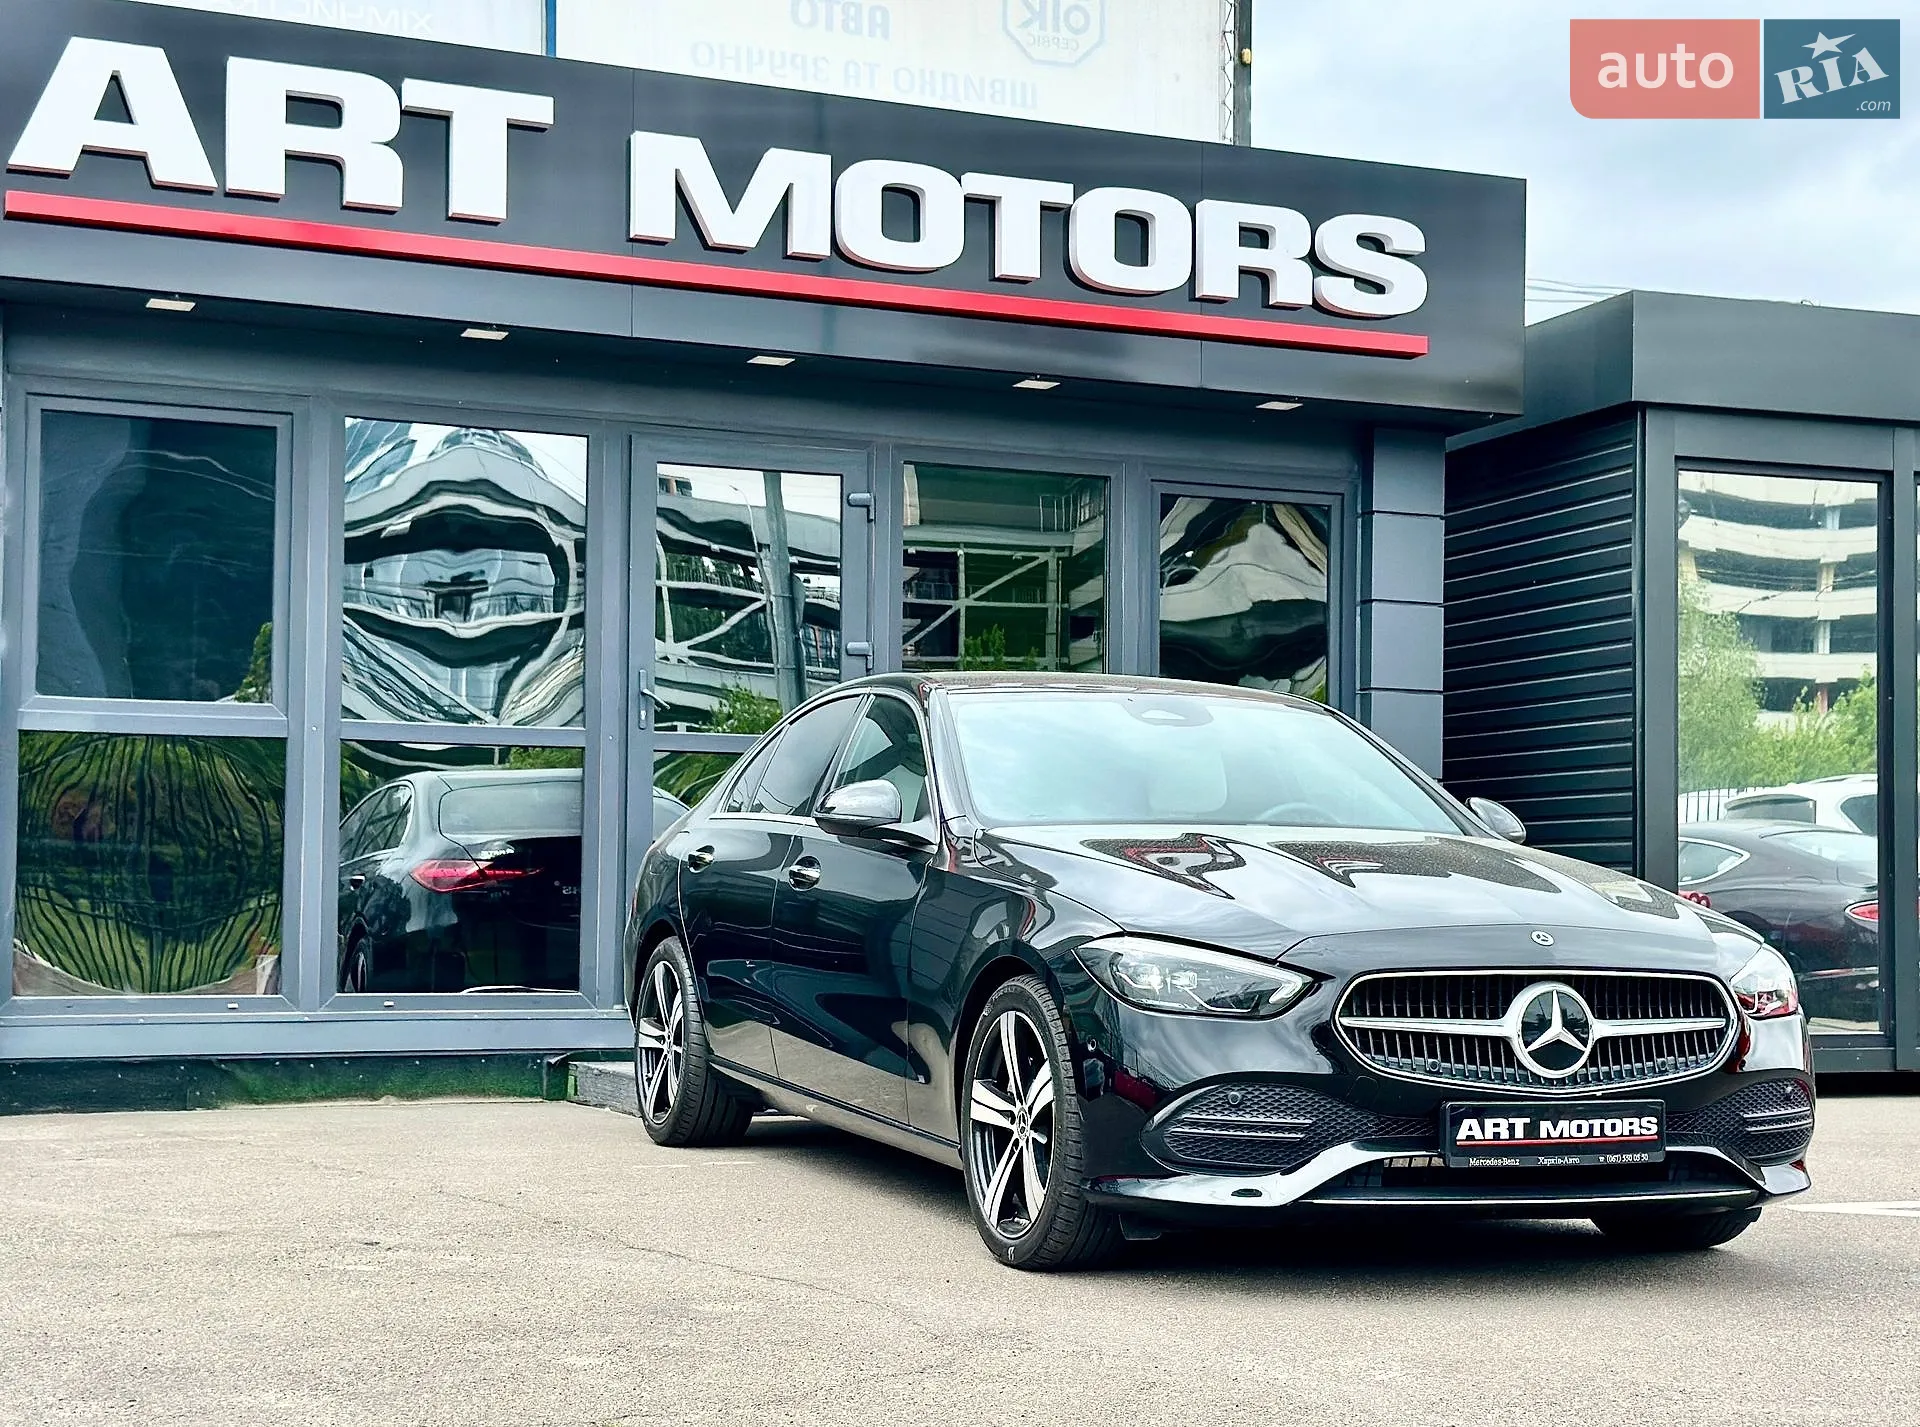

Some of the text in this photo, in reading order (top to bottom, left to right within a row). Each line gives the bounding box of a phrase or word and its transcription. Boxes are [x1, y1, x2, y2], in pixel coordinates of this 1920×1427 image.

[6, 36, 1428, 319] ART MOTORS
[1455, 1116, 1658, 1140] ART MOTORS
[1468, 1157, 1520, 1167] Mercedes-Benz
